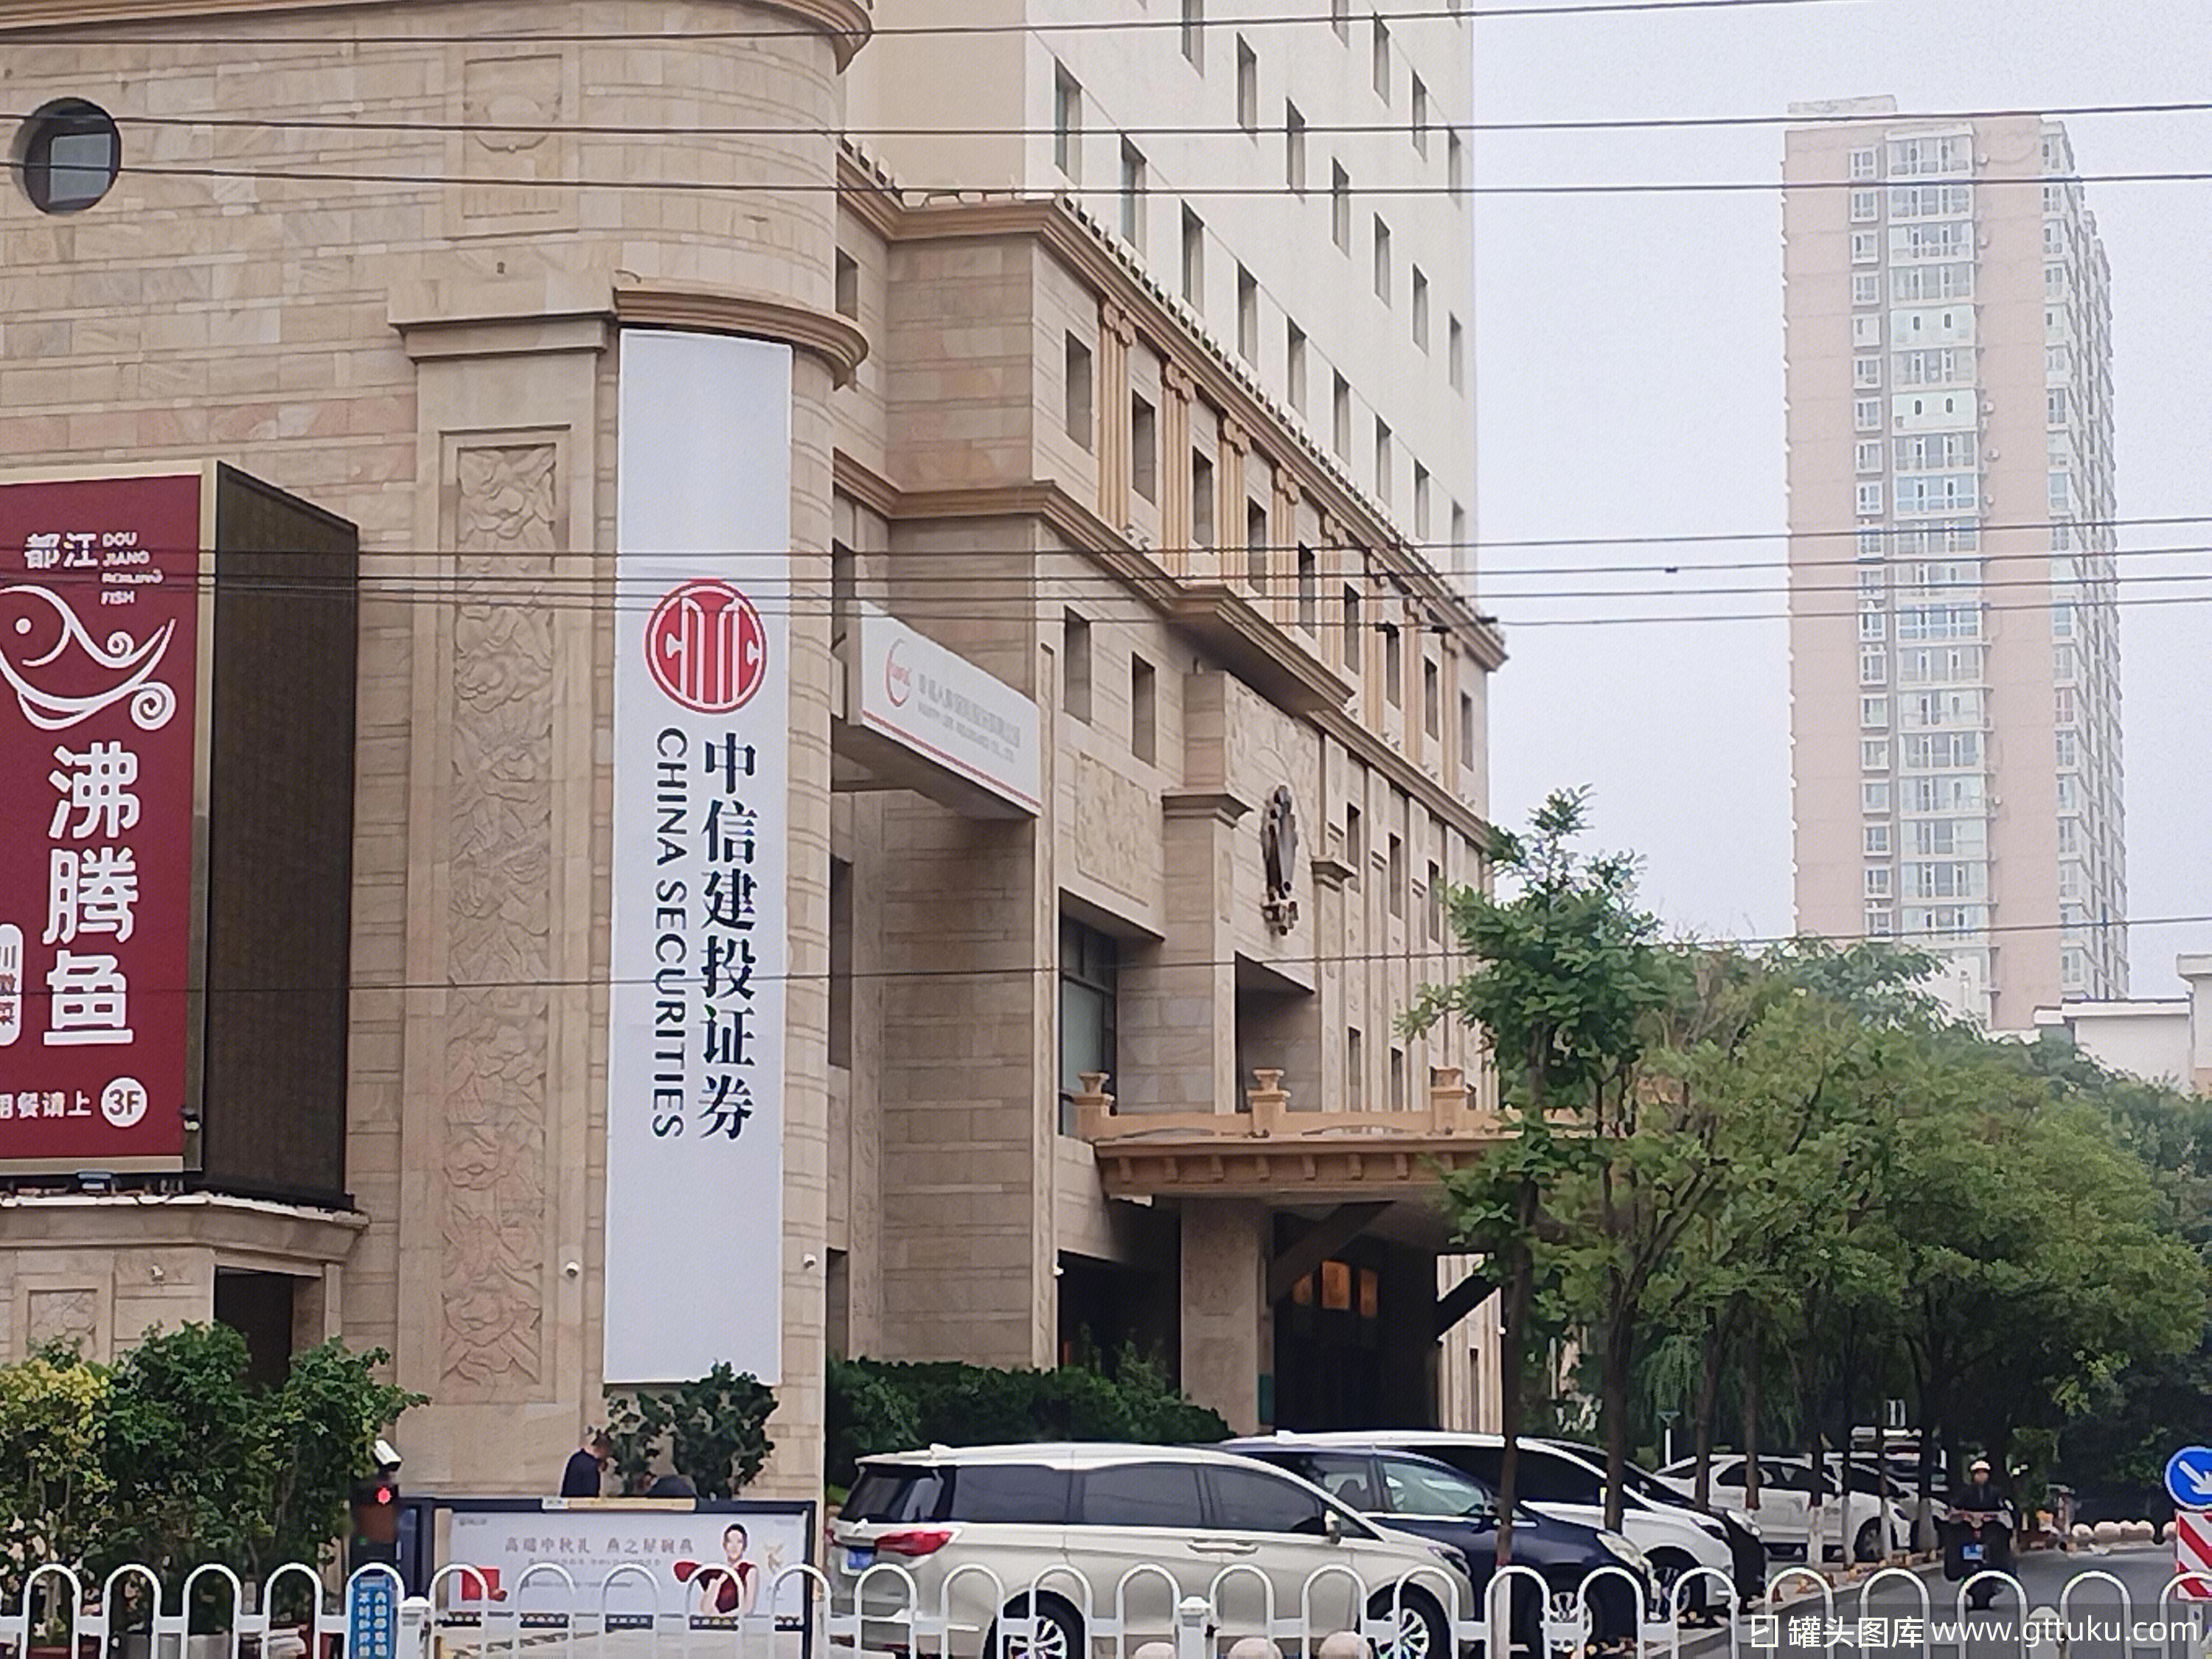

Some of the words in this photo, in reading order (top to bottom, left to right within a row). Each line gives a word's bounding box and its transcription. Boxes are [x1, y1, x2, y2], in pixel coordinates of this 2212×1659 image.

[24, 532, 98, 568] 都江
[102, 532, 138, 547] DOU
[102, 549, 150, 566] JIANG
[101, 591, 135, 605] FISH
[656, 728, 687, 866] CHINA
[42, 740, 140, 1046] 沸腾鱼
[697, 732, 758, 1140] 中信建投证券
[652, 880, 687, 1138] SECURITIES
[108, 1088, 141, 1116] 3F
